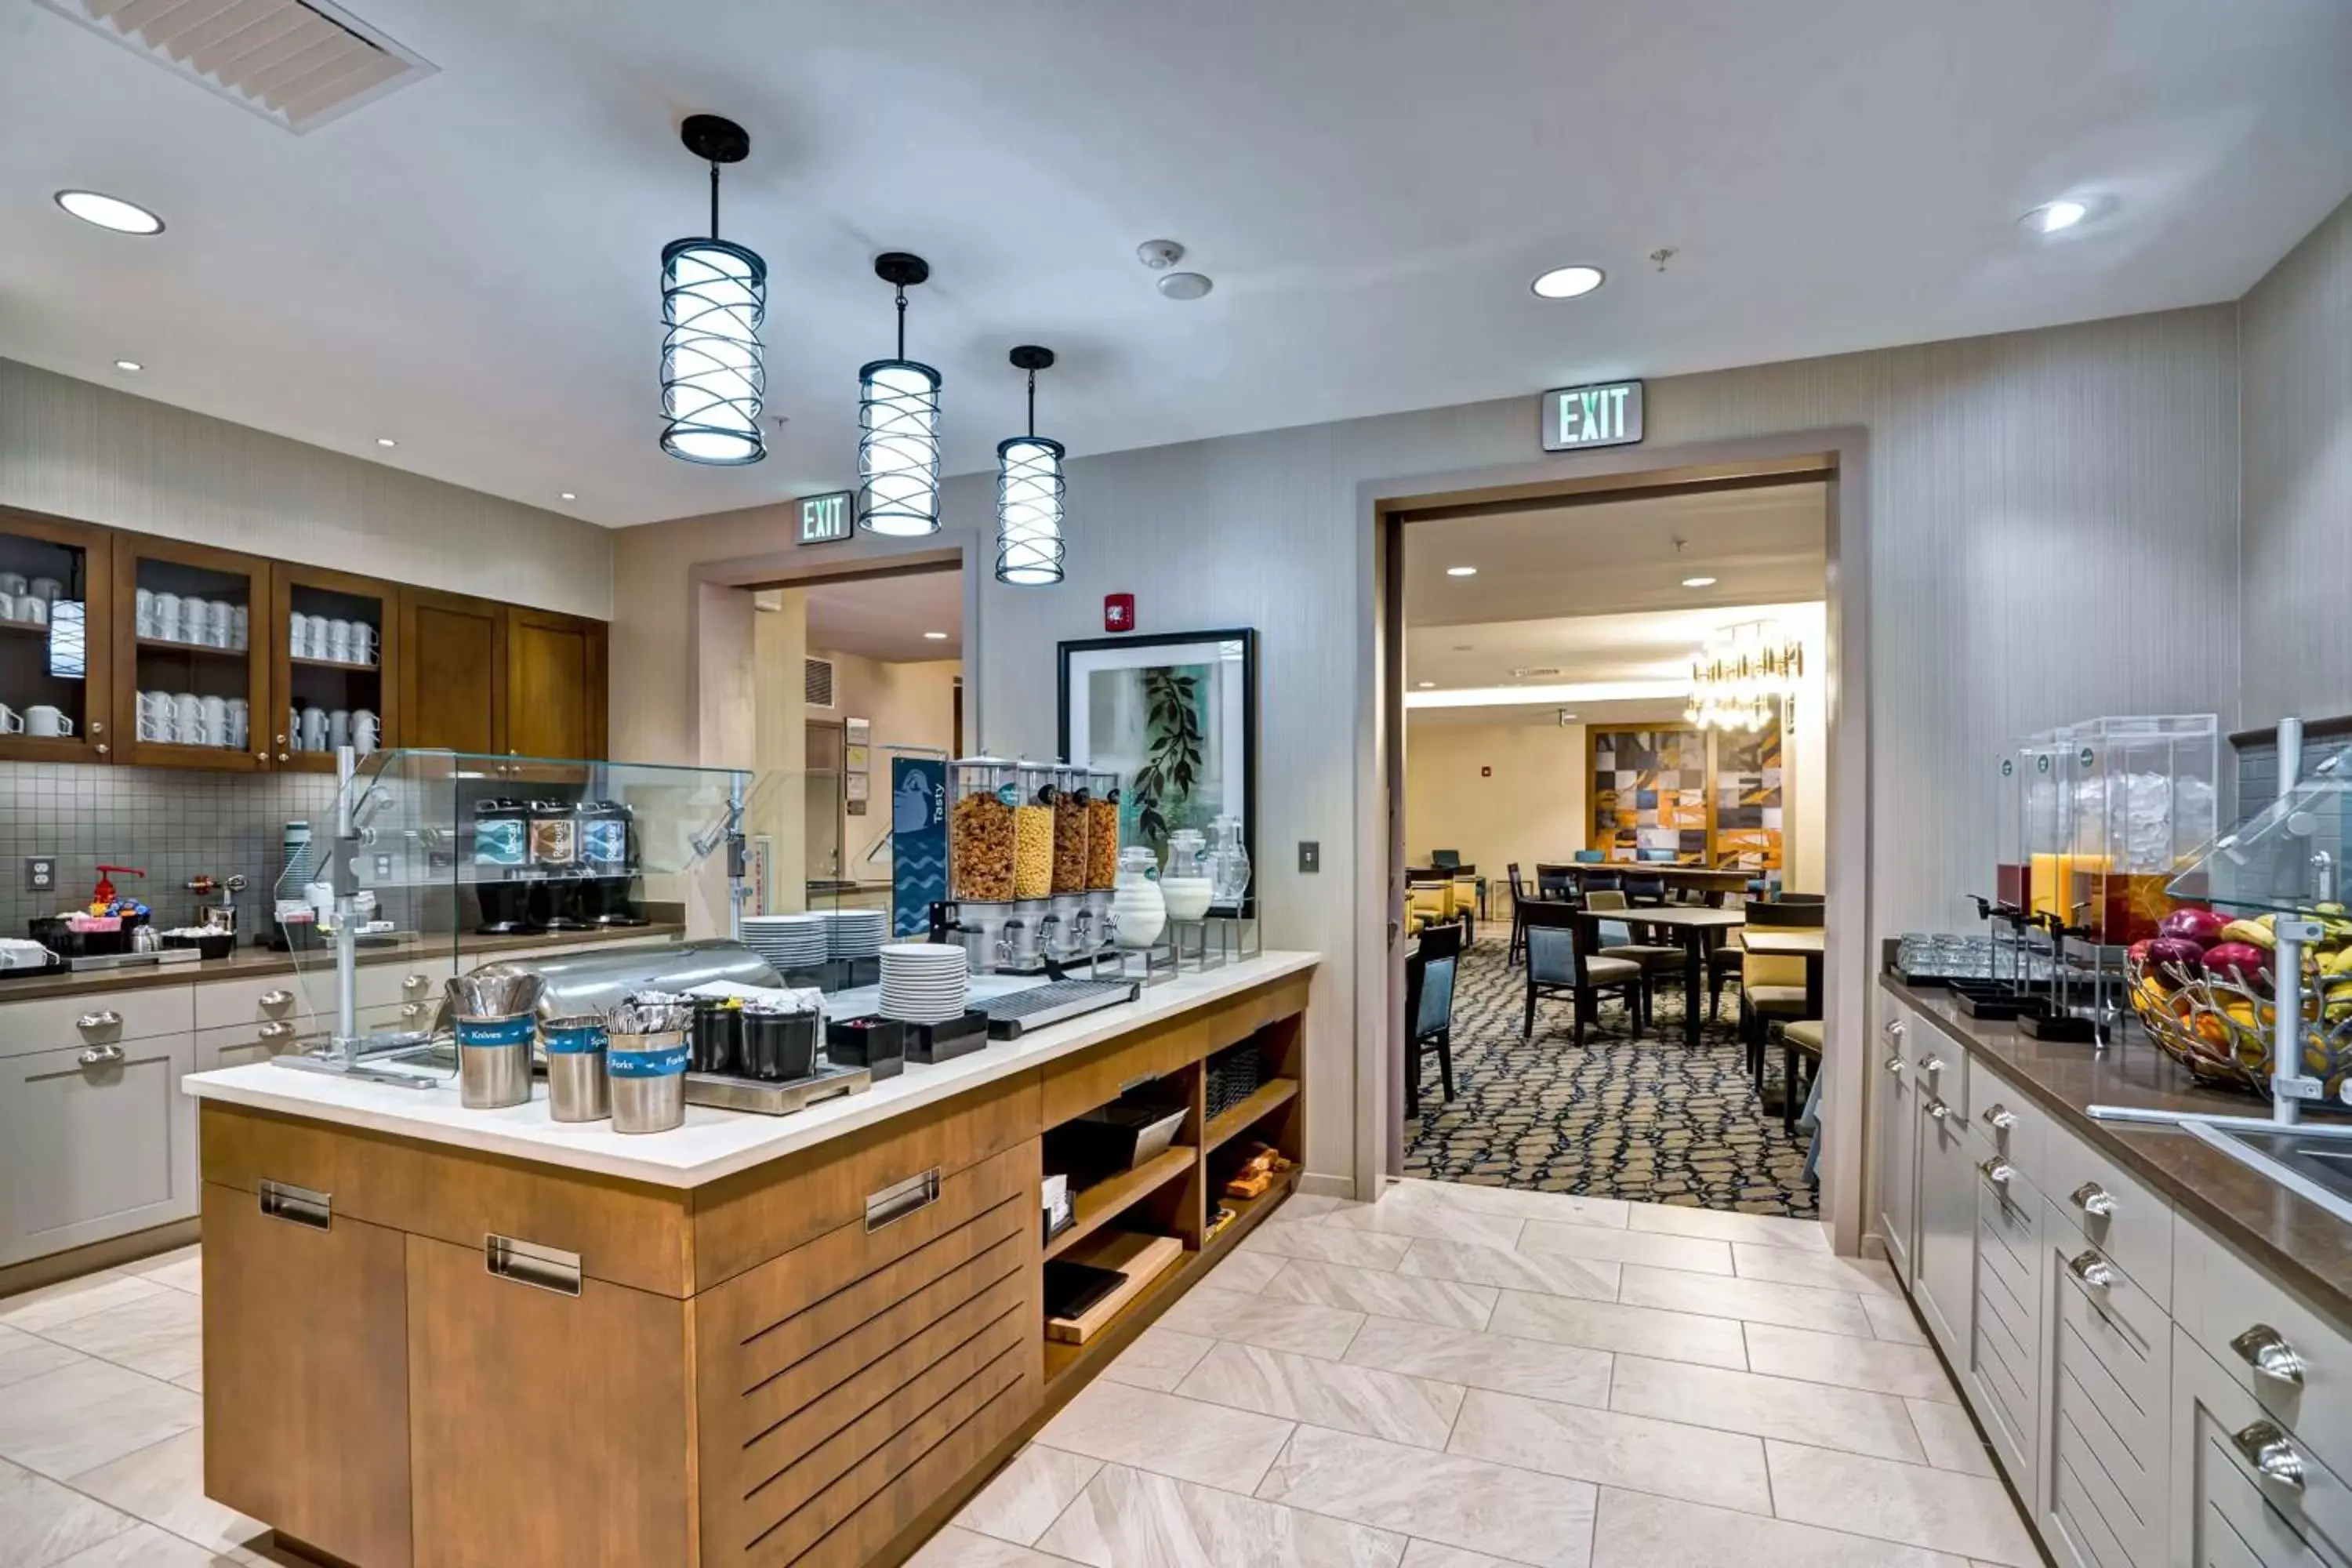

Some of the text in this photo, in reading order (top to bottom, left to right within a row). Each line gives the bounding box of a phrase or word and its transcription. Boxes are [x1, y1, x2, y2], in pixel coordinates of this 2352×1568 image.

[1560, 387, 1629, 443] EXIT
[804, 497, 843, 539] EXIT
[934, 783, 945, 824] Tasty
[471, 1030, 502, 1039] Knives
[612, 1058, 633, 1069] Forks
